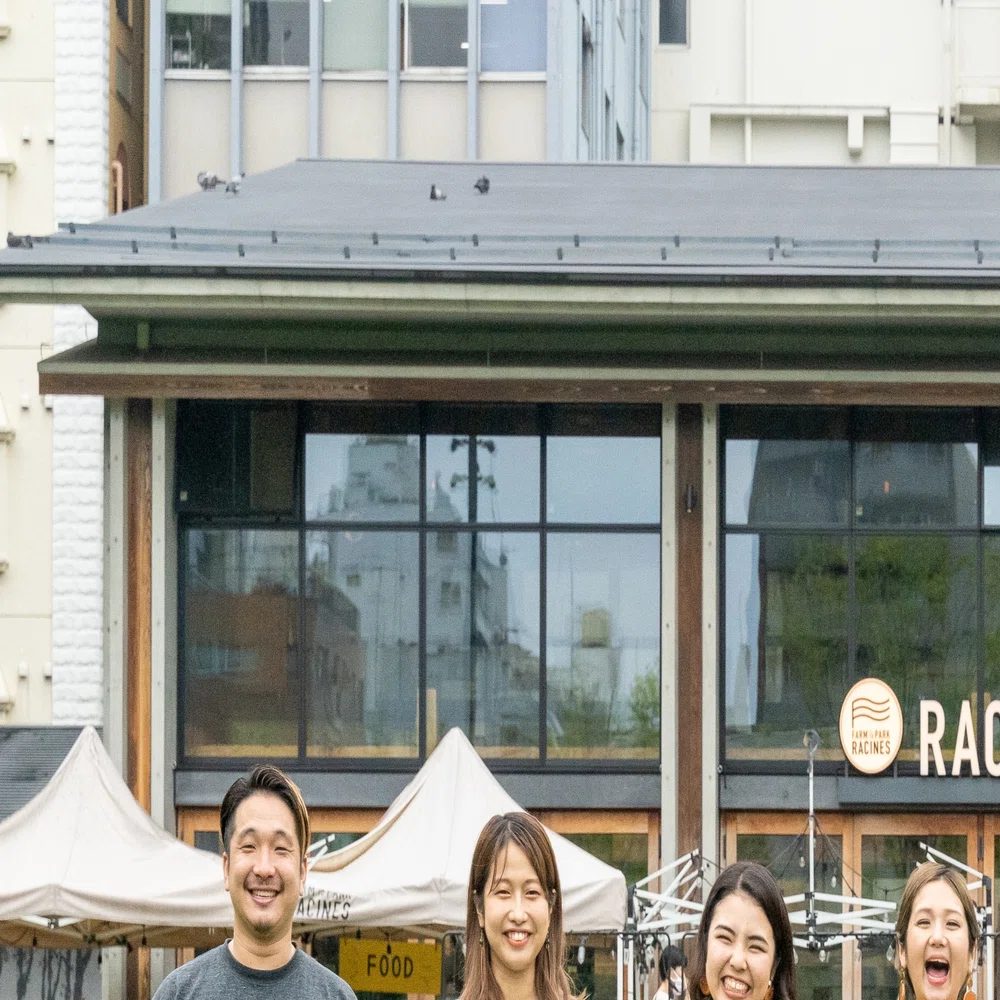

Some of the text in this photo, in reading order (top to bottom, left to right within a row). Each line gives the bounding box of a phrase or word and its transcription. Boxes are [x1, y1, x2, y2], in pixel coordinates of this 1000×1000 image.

[851, 740, 891, 755] RACINES
[296, 897, 351, 921] ACINES
[367, 953, 414, 979] FOOD
